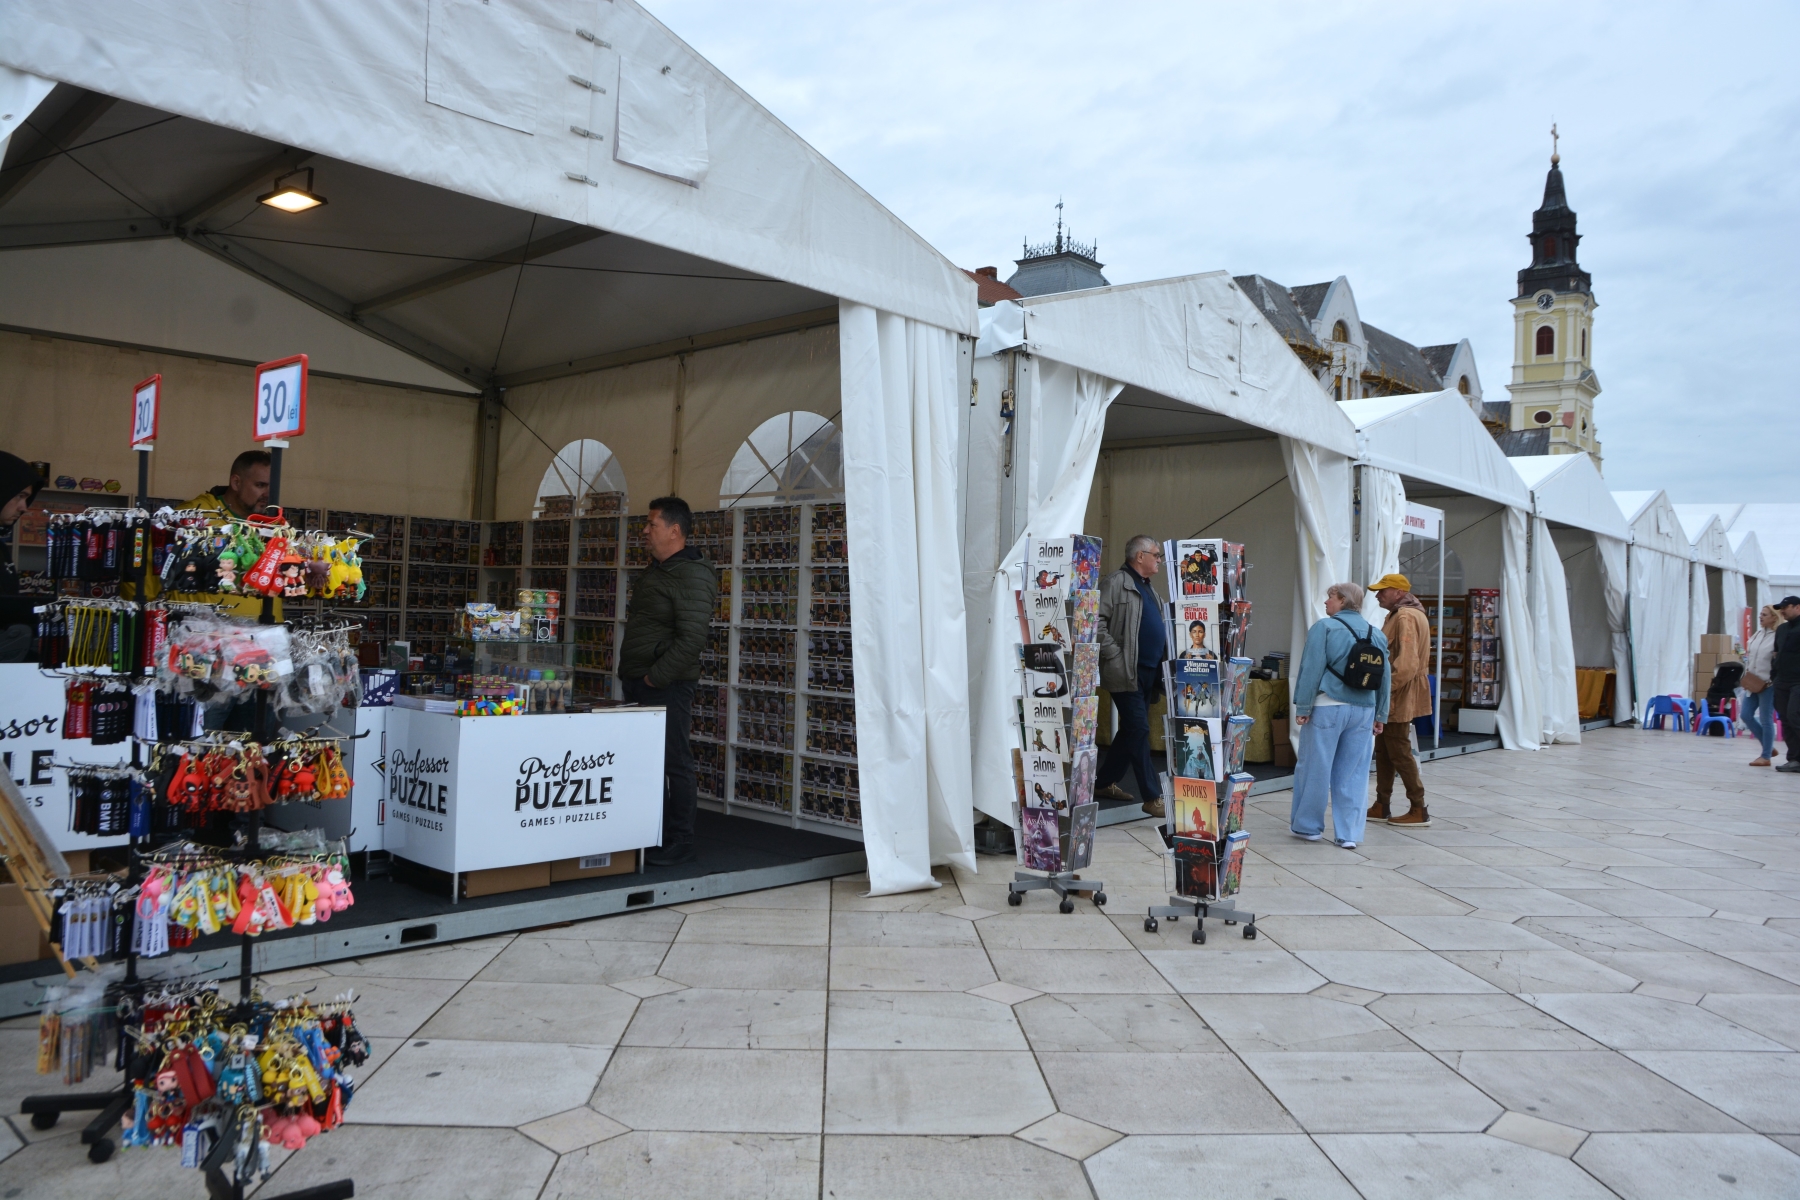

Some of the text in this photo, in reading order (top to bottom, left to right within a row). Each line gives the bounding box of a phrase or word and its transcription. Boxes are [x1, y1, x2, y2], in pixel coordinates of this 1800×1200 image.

[260, 380, 287, 424] 30
[136, 398, 150, 435] 30
[1039, 542, 1064, 558] alone
[19, 576, 53, 588] CORKS
[1035, 593, 1058, 609] alone
[1184, 612, 1208, 620] GULAG
[1360, 653, 1382, 665] FILA
[1034, 702, 1057, 718] alone
[390, 748, 449, 782] Professor
[516, 750, 615, 787] Professor
[1033, 756, 1057, 773] alone
[390, 774, 449, 815] PUZZLE
[514, 776, 614, 812] PUZZLE
[1182, 784, 1208, 799] SPOOKS
[1233, 782, 1251, 793] HULK
[99, 803, 112, 831] BMW
[392, 809, 443, 832] GAMES PUZZLES
[520, 811, 607, 828] GAMES PUZZLES
